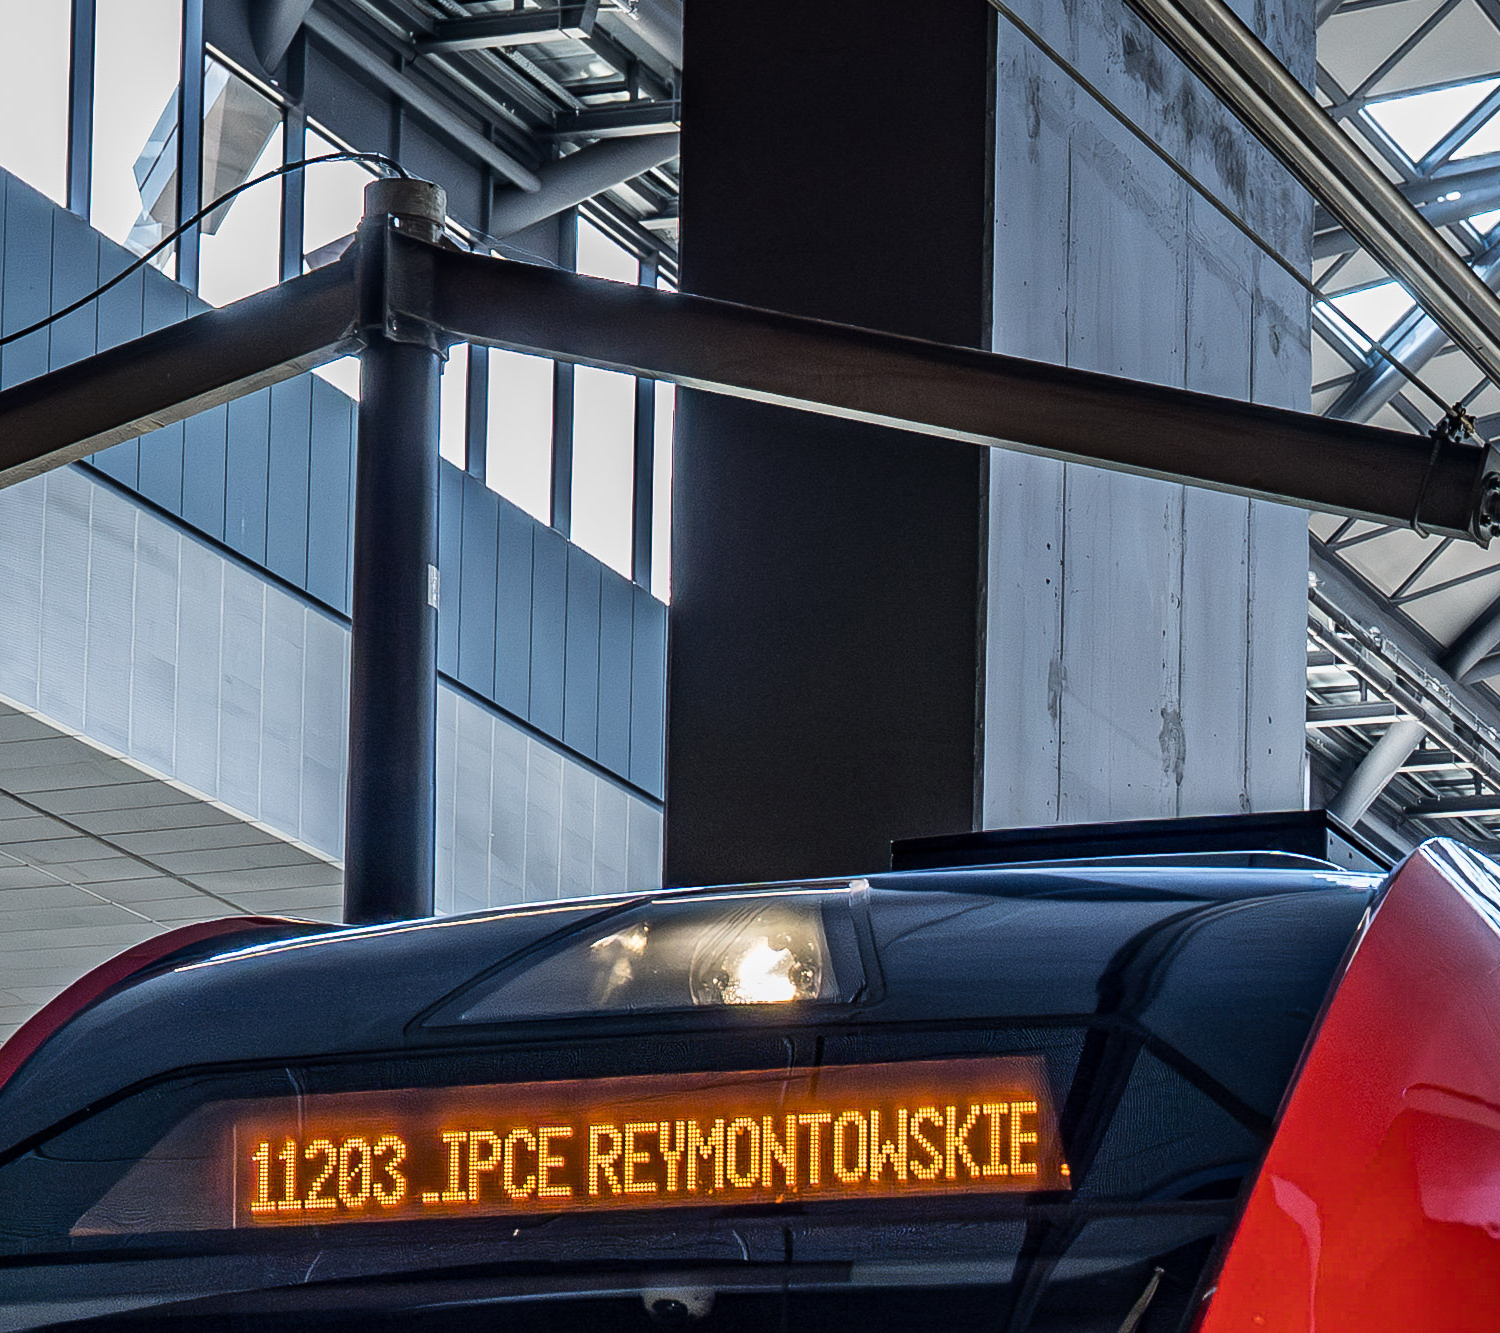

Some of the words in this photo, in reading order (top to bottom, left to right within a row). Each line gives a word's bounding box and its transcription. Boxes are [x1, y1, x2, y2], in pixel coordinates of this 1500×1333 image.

[251, 1136, 405, 1211] 11203
[422, 1126, 572, 1202] IPCE
[587, 1101, 1037, 1194] REYMONTOWSKIE
